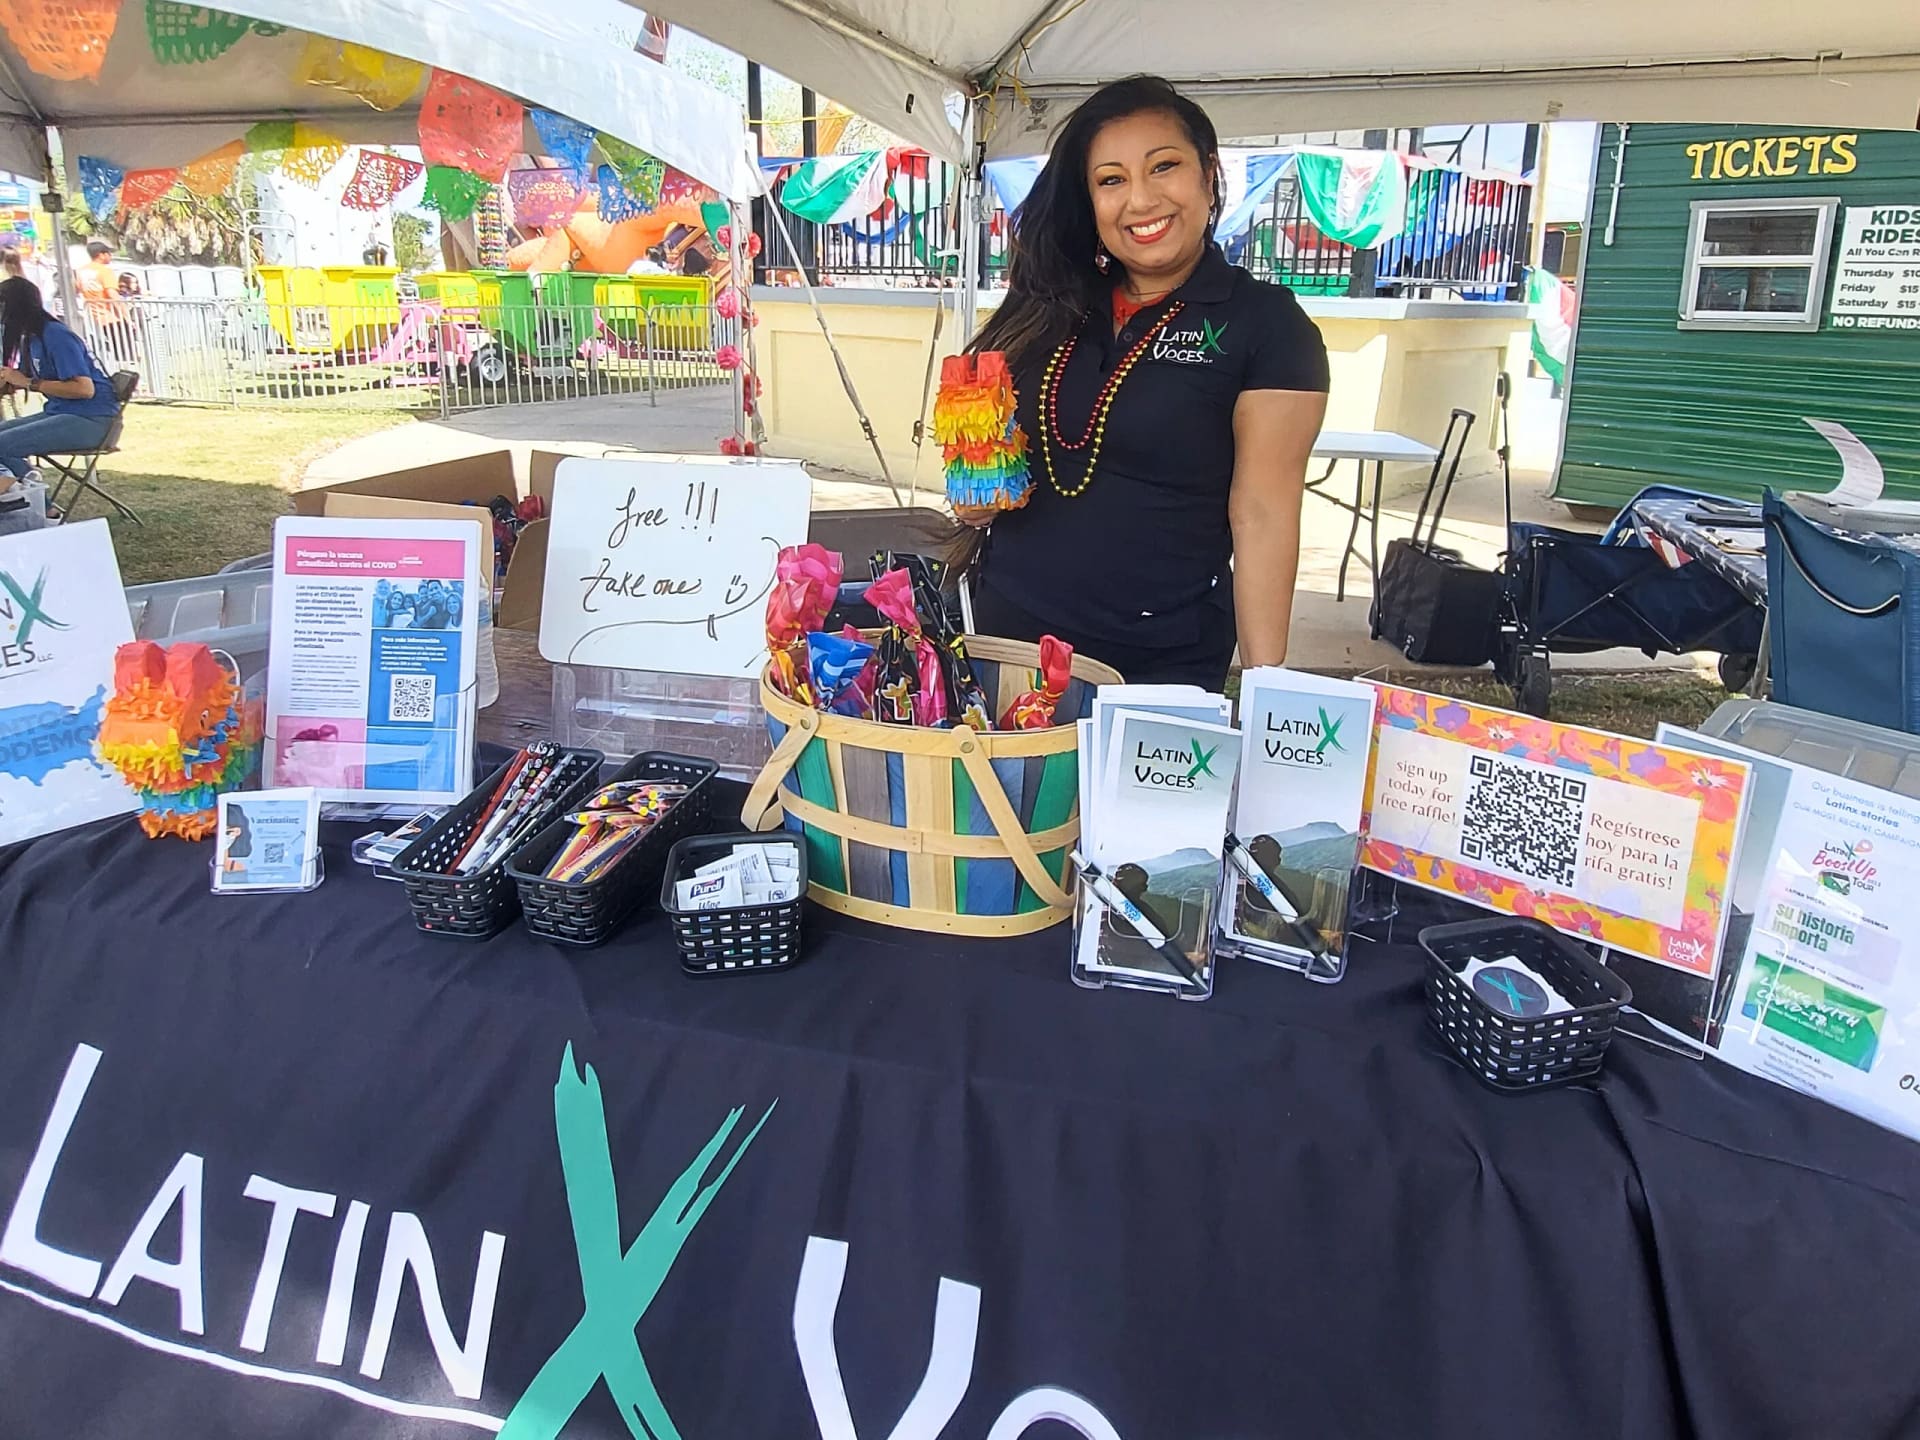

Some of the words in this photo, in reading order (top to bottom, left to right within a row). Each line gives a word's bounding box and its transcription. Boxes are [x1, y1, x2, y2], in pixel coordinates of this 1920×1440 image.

[1686, 134, 1858, 179] TICKETS
[1871, 210, 1920, 225] KIDS
[1847, 248, 1862, 256] All
[1865, 248, 1885, 256] You
[1888, 248, 1910, 256] Can
[1843, 269, 1894, 279] Thursday
[1840, 284, 1875, 293] Friday
[1838, 299, 1888, 308] Saturday
[1832, 316, 1855, 327] NO
[1153, 342, 1205, 363] VOCES
[580, 558, 647, 612] take
[653, 577, 703, 594] one
[1265, 739, 1325, 765] VOCES
[1135, 765, 1196, 788] VOCES
[1397, 760, 1425, 778] sign
[1429, 770, 1448, 785] up
[1388, 778, 1426, 798] today
[1432, 787, 1453, 803] for
[1381, 792, 1408, 811] free
[1412, 804, 1457, 827] raffle!
[1826, 797, 1858, 814] Latinx
[1861, 810, 1899, 828] stories
[1590, 813, 1681, 848] Regístrese
[1585, 832, 1617, 855] hoy
[1621, 846, 1658, 864] para
[1664, 853, 1678, 870] la
[1584, 856, 1612, 873] rifa
[1617, 866, 1672, 890] gratis!
[1771, 916, 1828, 952] importa
[1797, 909, 1856, 945] historia
